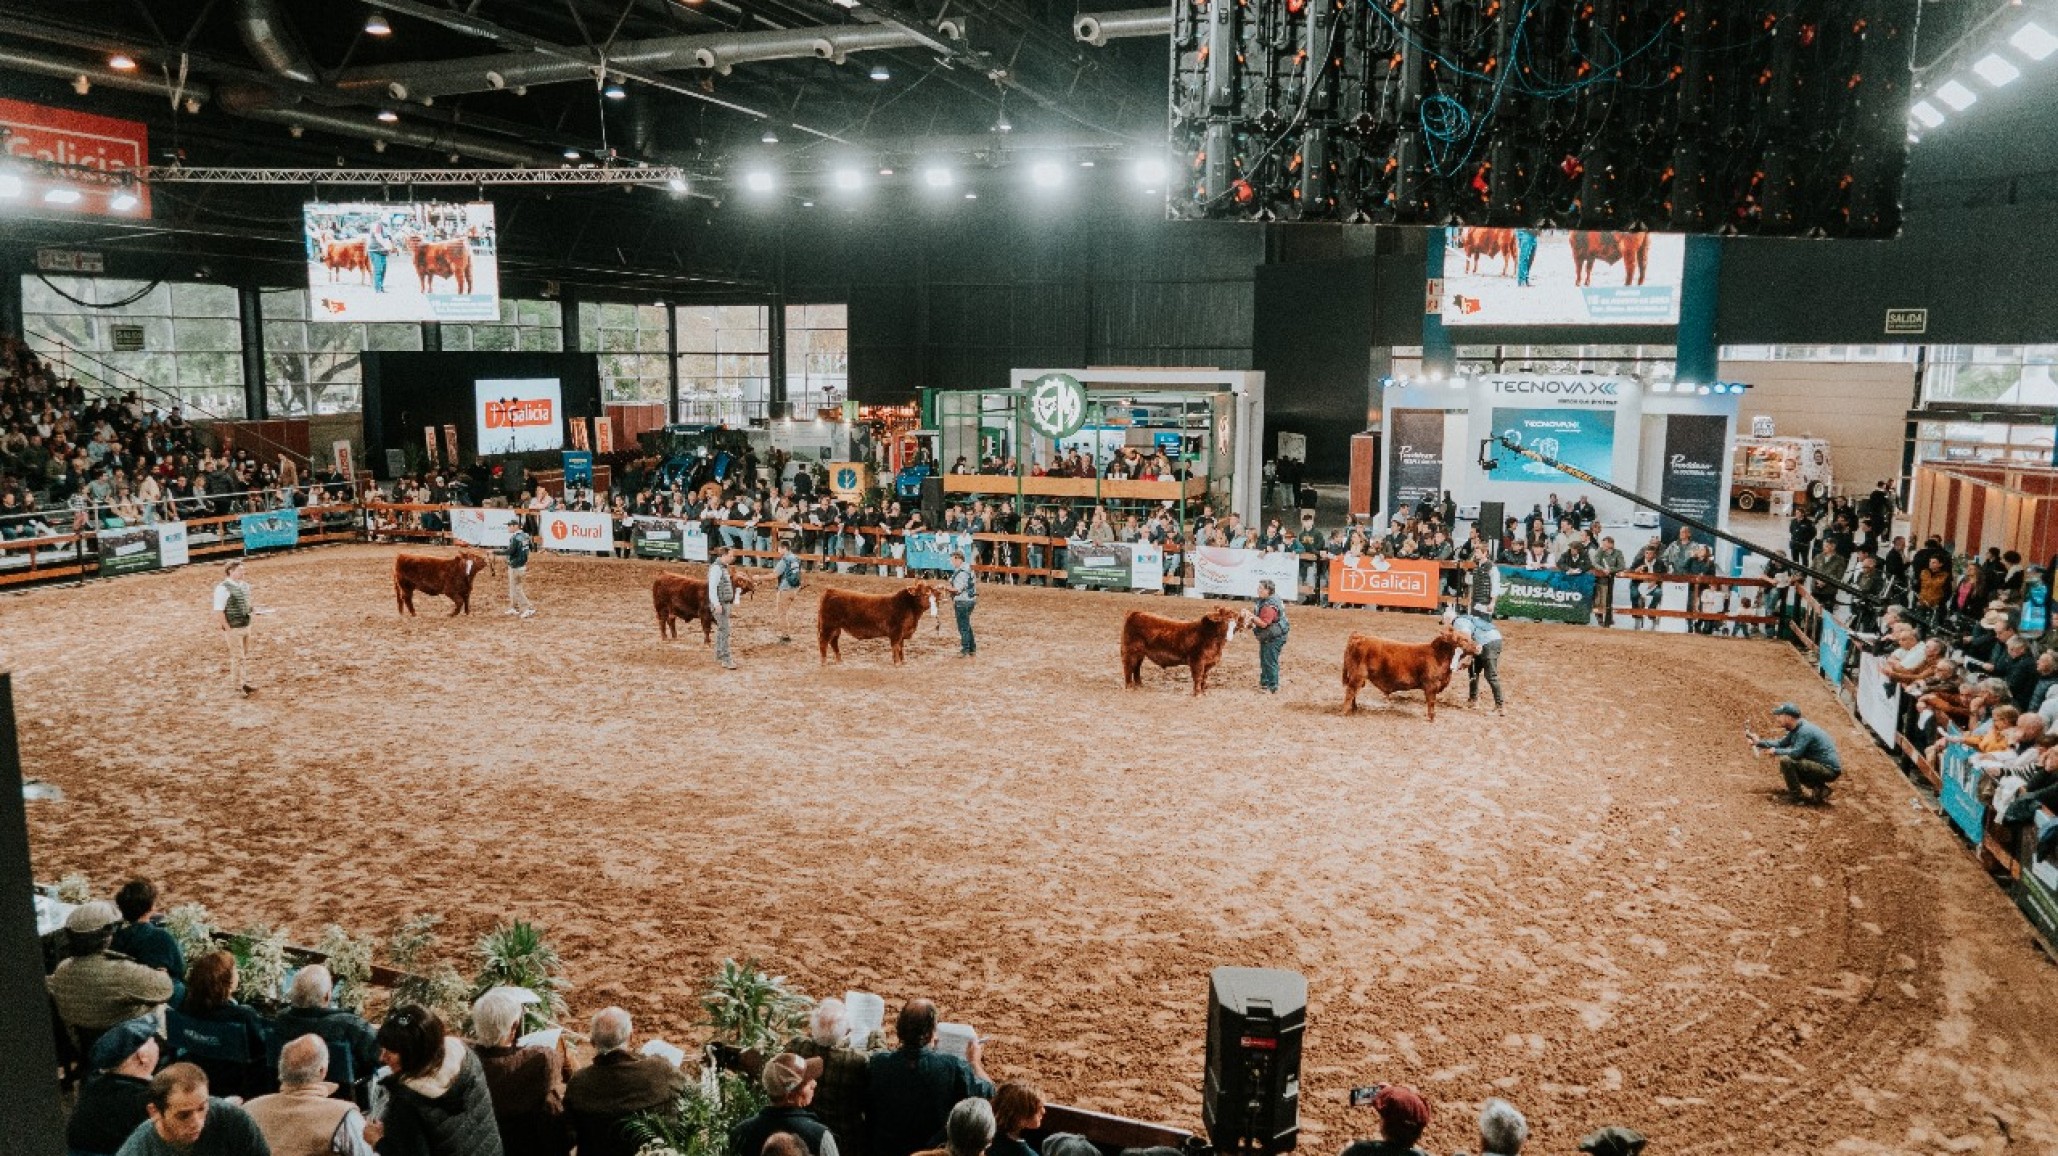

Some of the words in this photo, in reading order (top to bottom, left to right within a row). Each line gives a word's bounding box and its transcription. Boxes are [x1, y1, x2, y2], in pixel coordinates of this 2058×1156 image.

[1889, 313, 1922, 323] SALIDA
[1491, 380, 1618, 395] TECNOVAX
[571, 523, 602, 539] Rural
[1369, 574, 1420, 590] Galicia
